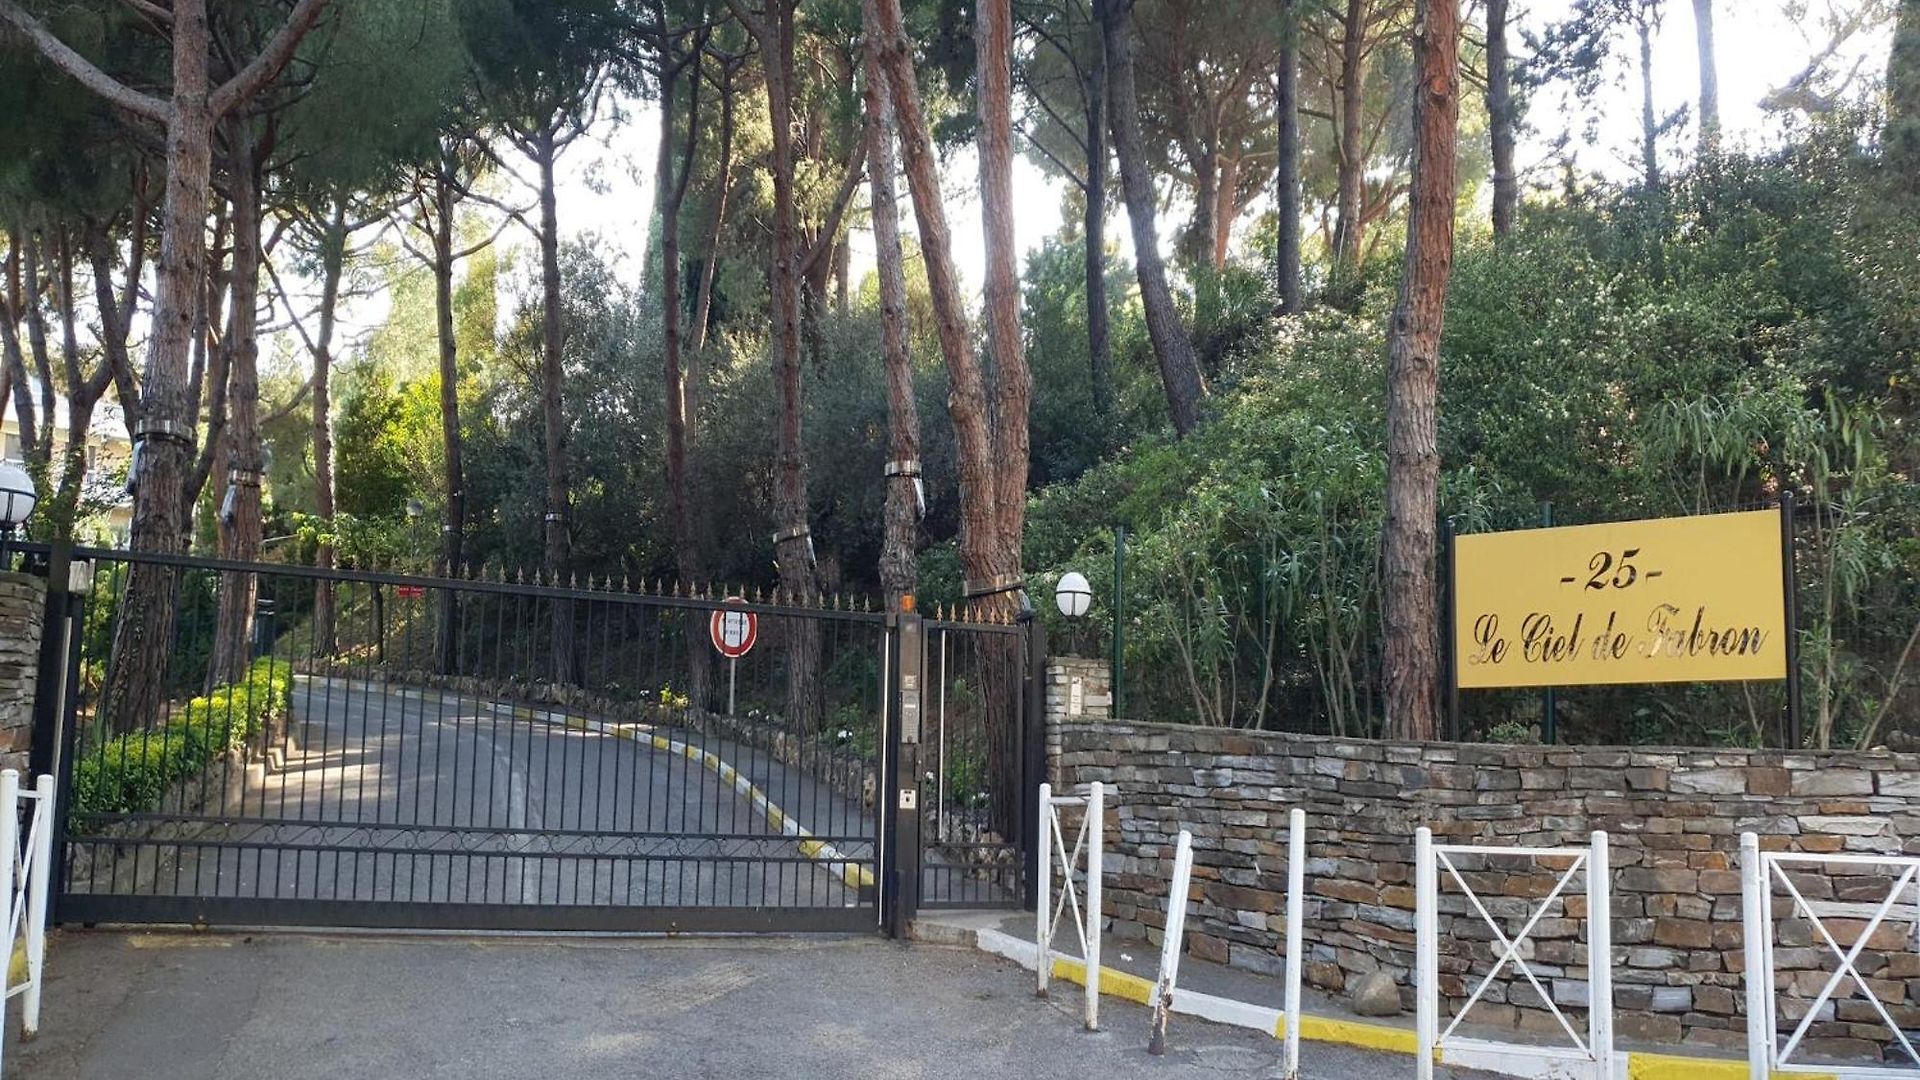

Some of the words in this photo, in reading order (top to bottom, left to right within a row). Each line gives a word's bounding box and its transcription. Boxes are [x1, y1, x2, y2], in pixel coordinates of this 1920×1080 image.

[1469, 613, 1510, 666] Le
[1521, 612, 1584, 664] Ciel
[1592, 611, 1632, 661] de
[1640, 603, 1767, 658] Fabron
